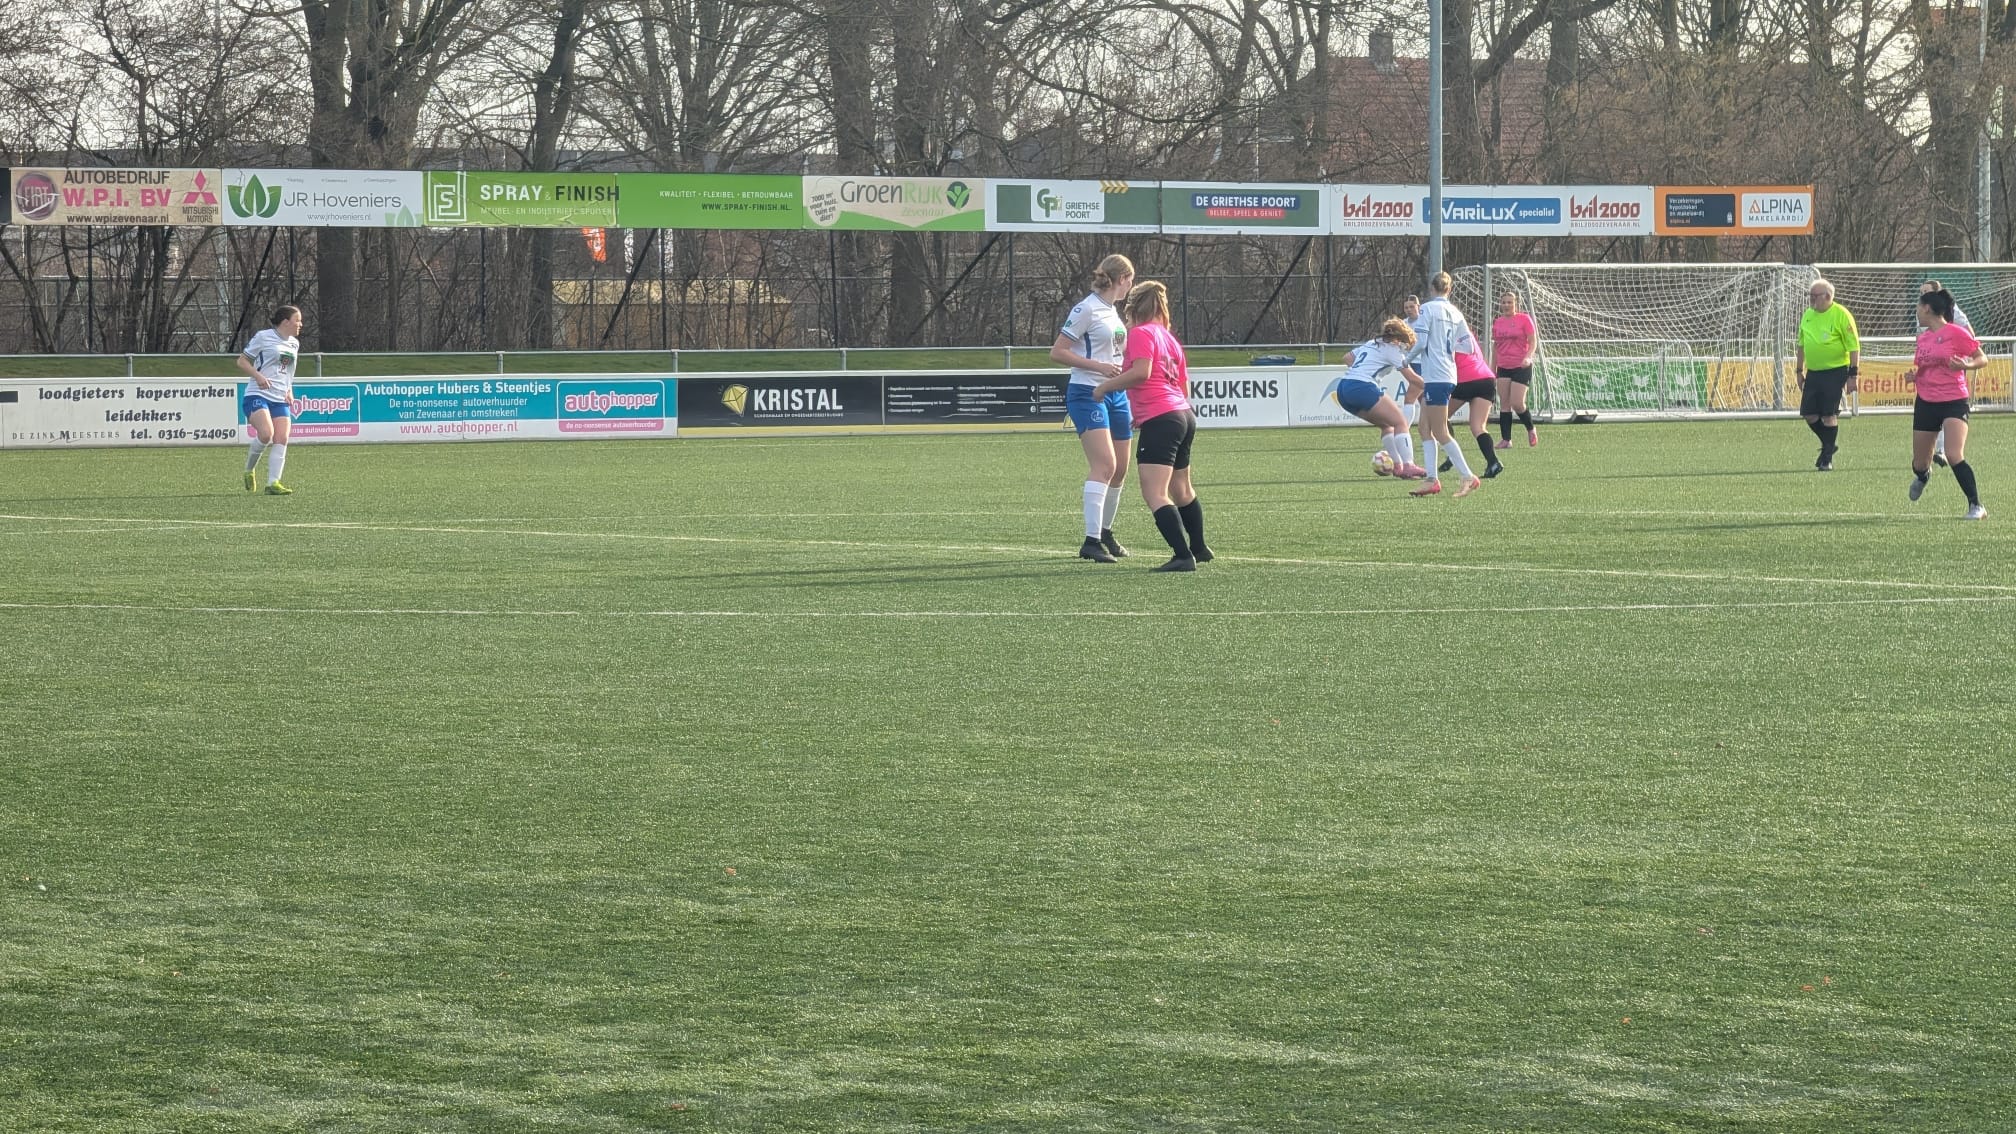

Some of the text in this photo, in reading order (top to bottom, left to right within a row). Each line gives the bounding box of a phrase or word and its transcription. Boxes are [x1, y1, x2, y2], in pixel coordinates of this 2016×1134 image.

[64, 170, 170, 184] AUTOBEDRIJF
[63, 188, 171, 206] W.P.I. BV
[480, 184, 543, 201] SPRAY
[555, 185, 620, 201] FINISH
[284, 192, 401, 207] JR Hoveniers
[1196, 195, 1296, 207] DE GRIETHSE POORT
[183, 207, 218, 215] MITSUBISHI
[1066, 202, 1100, 210] GRIETHSE
[1749, 199, 1803, 214] ALPINA
[307, 213, 371, 221] www.jrhoveniers.nl
[1519, 208, 1555, 217] specialist
[67, 214, 169, 224] www.wpizevenaar.nl
[187, 215, 213, 223] MOTORS
[1352, 352, 1368, 369] 2
[39, 386, 234, 401] loodgieters koperwerken
[364, 382, 551, 397] Autohopper Hubers & Steentjes
[1190, 380, 1279, 399] KEUKENS
[390, 397, 528, 408] De no-nonsense autoverhuurder
[565, 390, 659, 415] autohopper
[754, 388, 843, 411] KRISTAL
[105, 410, 182, 422] leidekkers
[416, 410, 456, 418] Zevenaar
[471, 408, 518, 417] omstreken!
[400, 421, 518, 434] www.autohopper.nl
[12, 432, 25, 440] DE
[59, 431, 120, 440] MEESTERS
[131, 429, 236, 440] tel. 0316-524050
